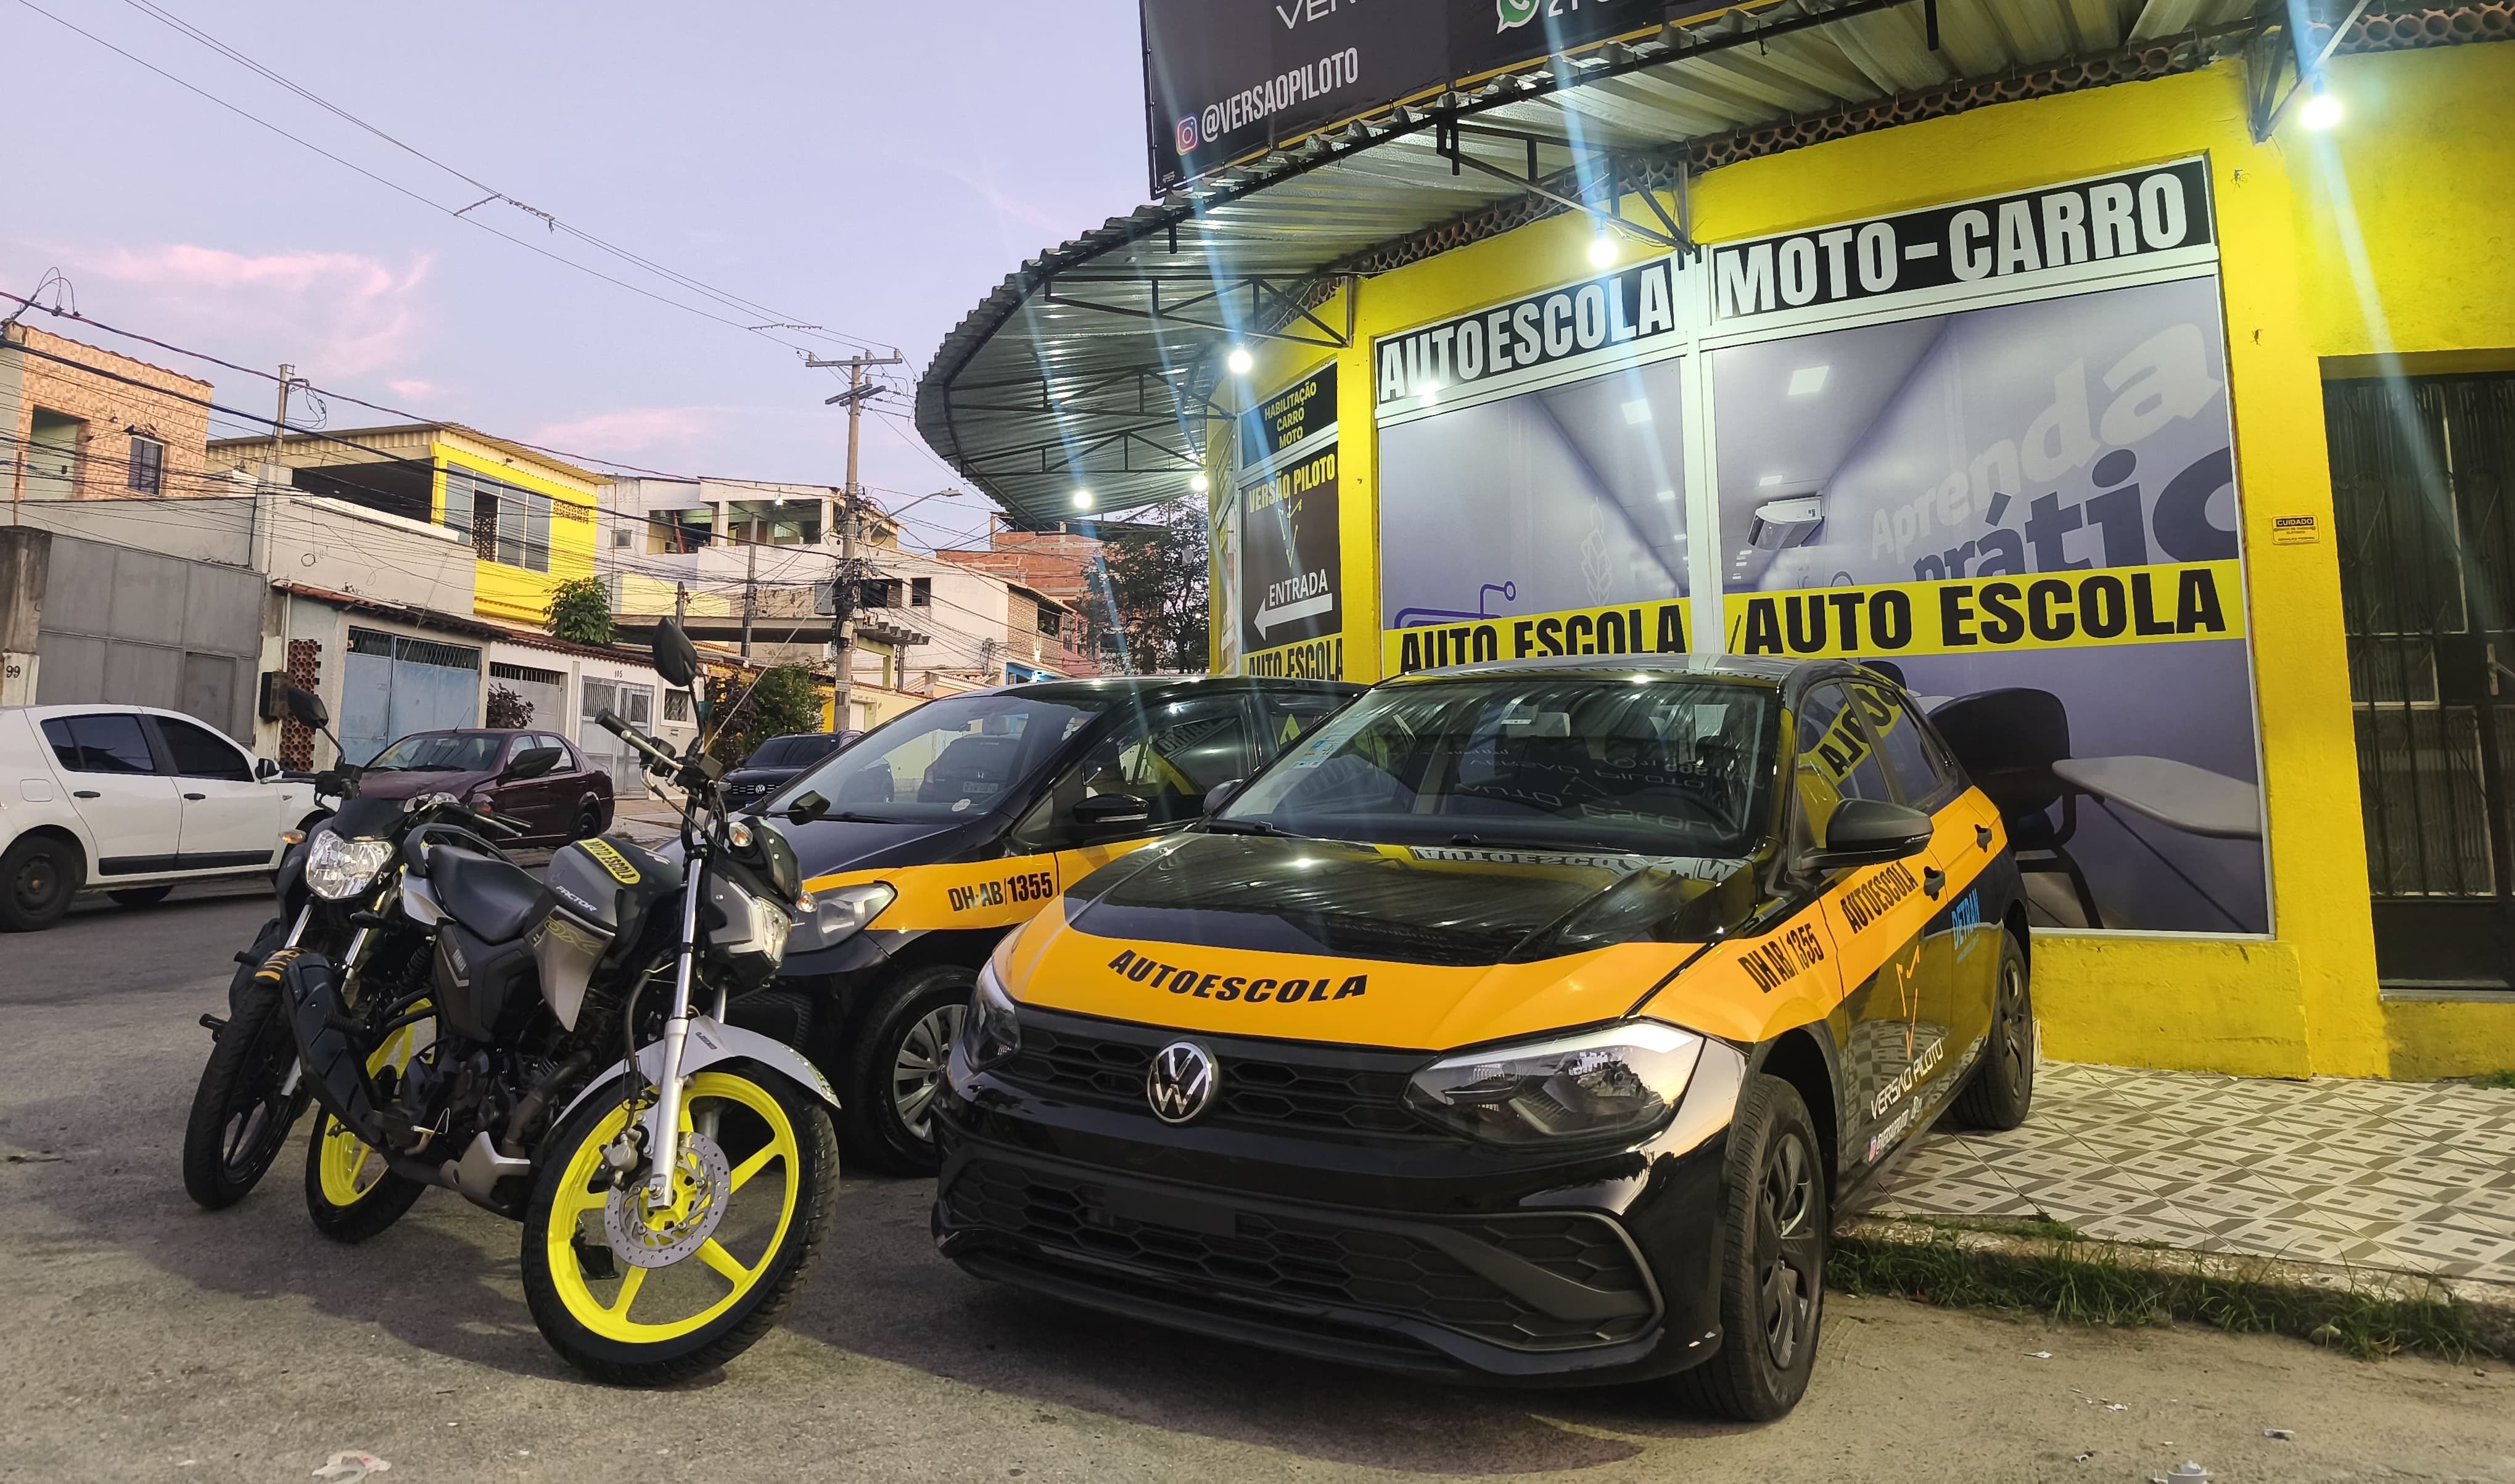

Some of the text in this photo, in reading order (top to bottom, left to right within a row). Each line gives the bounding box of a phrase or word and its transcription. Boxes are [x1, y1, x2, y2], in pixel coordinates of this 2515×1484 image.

[1201, 47, 1359, 143] @VERSAOPILOTO
[1381, 264, 1673, 401] AUTOESCOLA
[1265, 381, 1317, 420] HABILITAÇÃO
[1277, 407, 1304, 432] CARRO
[1279, 426, 1303, 449] MOTO
[1871, 322, 2224, 564] Aprenda
[1248, 453, 1335, 514] VERSÃO PILOTO
[2277, 518, 2313, 526] CUIDADO
[1269, 568, 1328, 607] ENTRADA
[1940, 568, 2227, 647] ESCOLA
[1400, 604, 1687, 673] AUTO ESCOLA
[6, 665, 21, 678] 99
[614, 670, 623, 678] 105
[602, 856, 636, 880] ESCOLA
[556, 885, 598, 912] FACTOR
[1840, 860, 1919, 934] AUTOESCOLA
[1951, 888, 1980, 951] DETRAN
[1108, 949, 1368, 1003] AUTOESCOLA
[1871, 1038, 1943, 1120] VERSAO PILOTO
